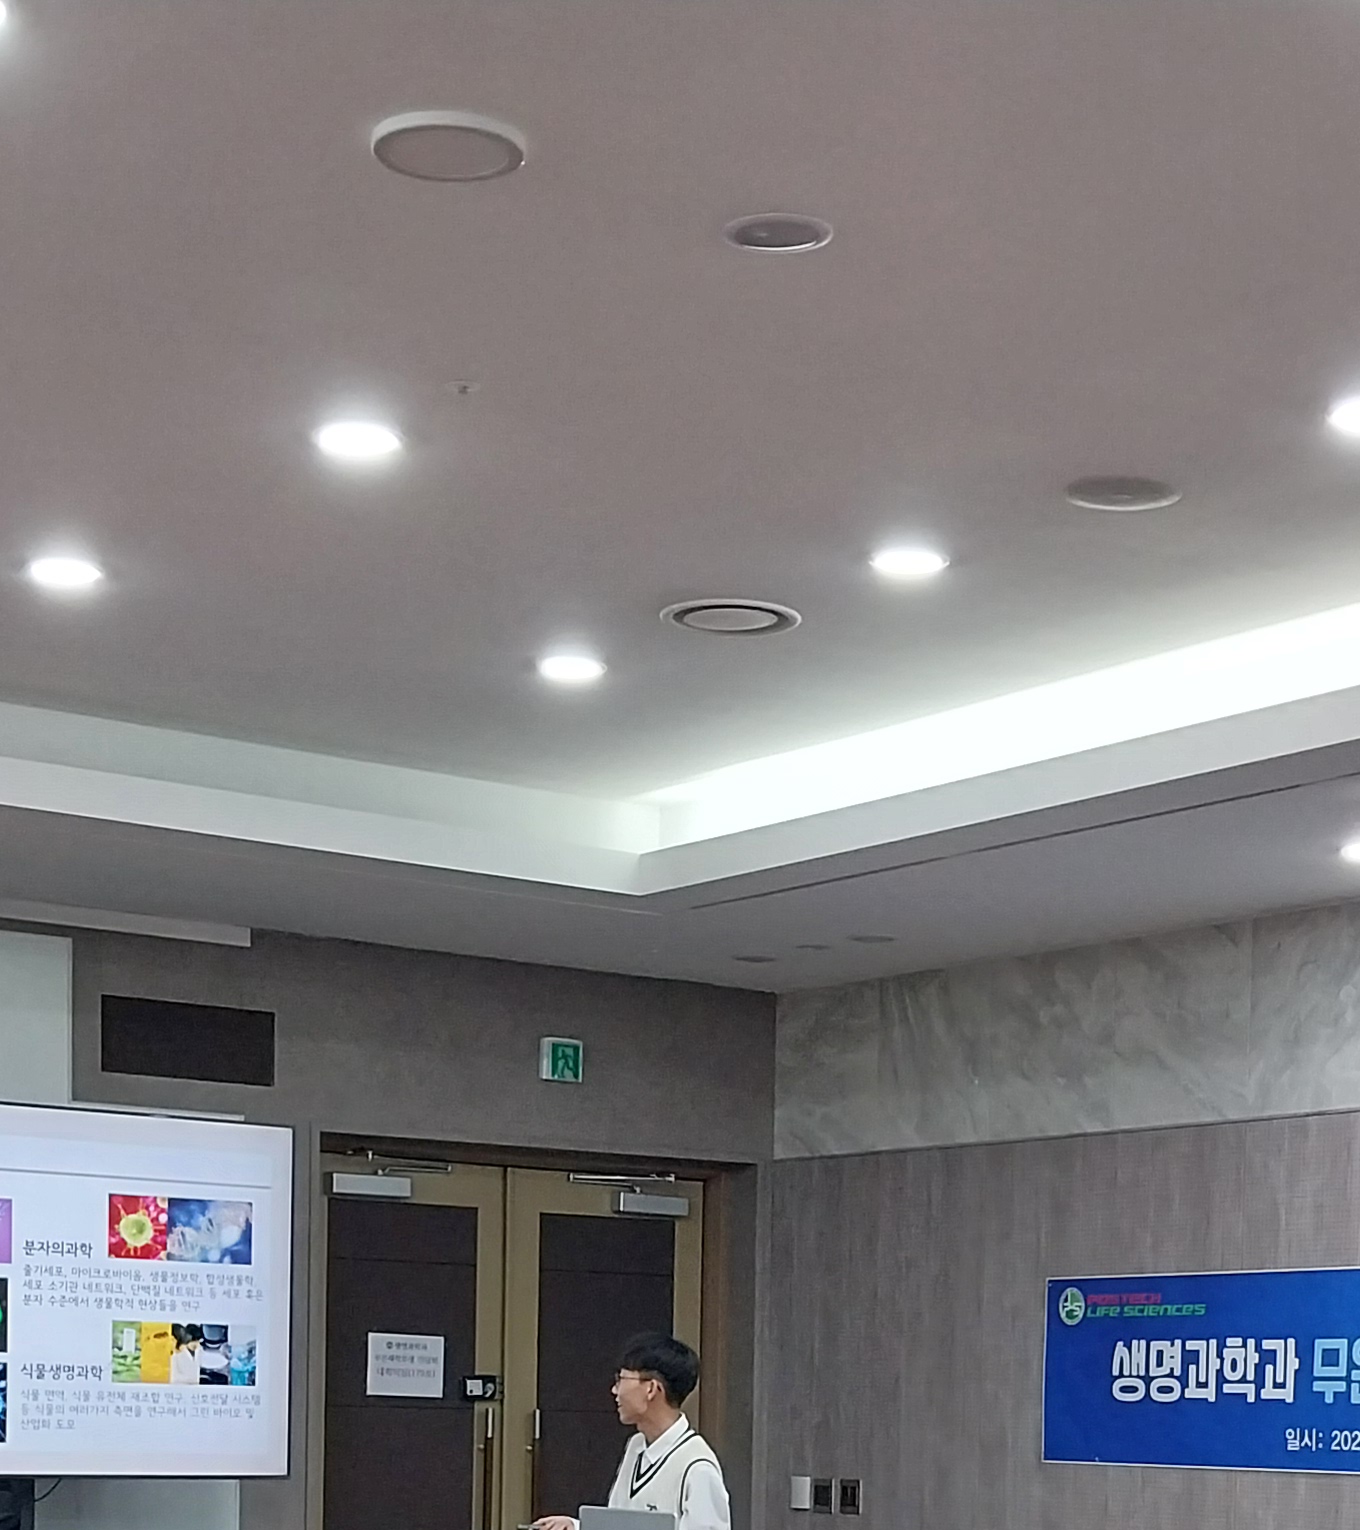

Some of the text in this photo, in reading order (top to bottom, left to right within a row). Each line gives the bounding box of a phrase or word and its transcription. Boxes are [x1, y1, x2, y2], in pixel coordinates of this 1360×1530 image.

[22, 1239, 92, 1258] 분자의과학
[1086, 1293, 1161, 1305] POSTECH
[21, 1363, 103, 1381] 식물생명과학
[1111, 1337, 1300, 1403] 생명과학과
[1285, 1427, 1324, 1452] 일시:
